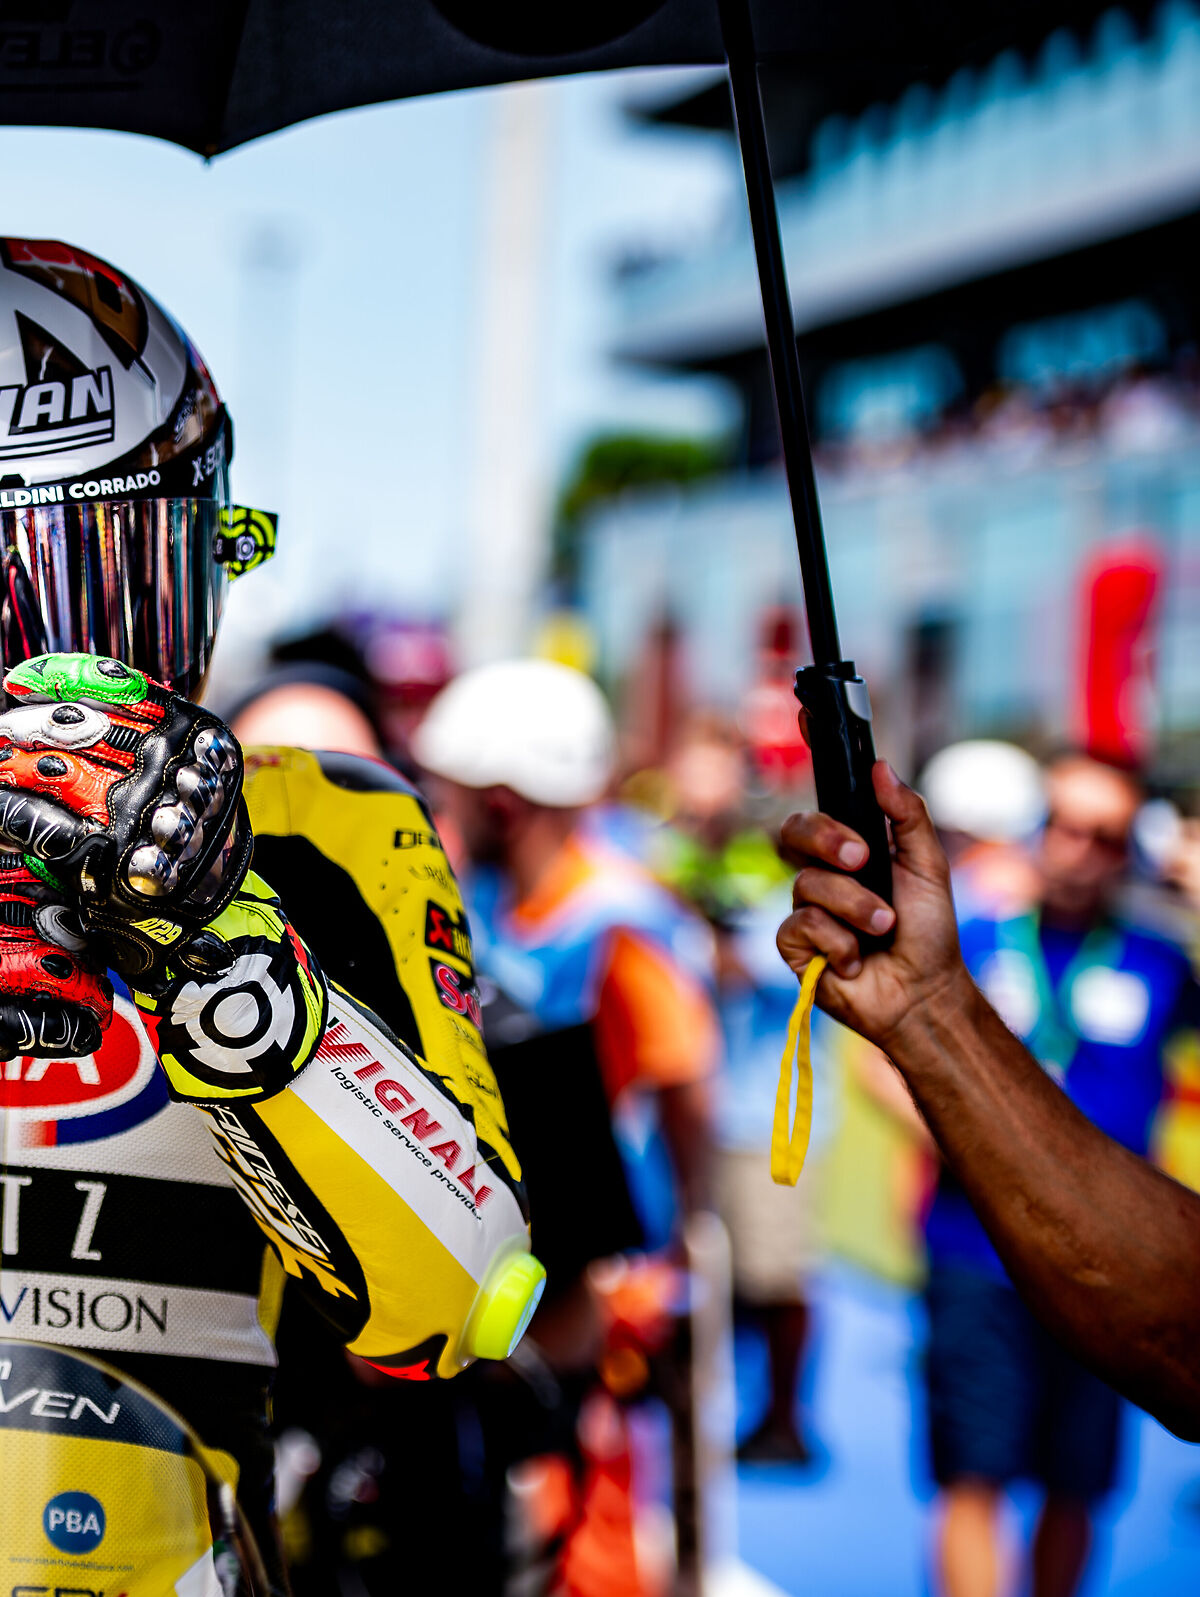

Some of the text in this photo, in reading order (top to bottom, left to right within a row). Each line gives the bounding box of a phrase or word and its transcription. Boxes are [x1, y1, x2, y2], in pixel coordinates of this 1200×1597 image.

[68, 470, 161, 499] CORRADO
[330, 1066, 383, 1118] logistic
[383, 1119, 433, 1168] service
[217, 1106, 332, 1254] AINESE
[48, 1507, 102, 1535] PBA
